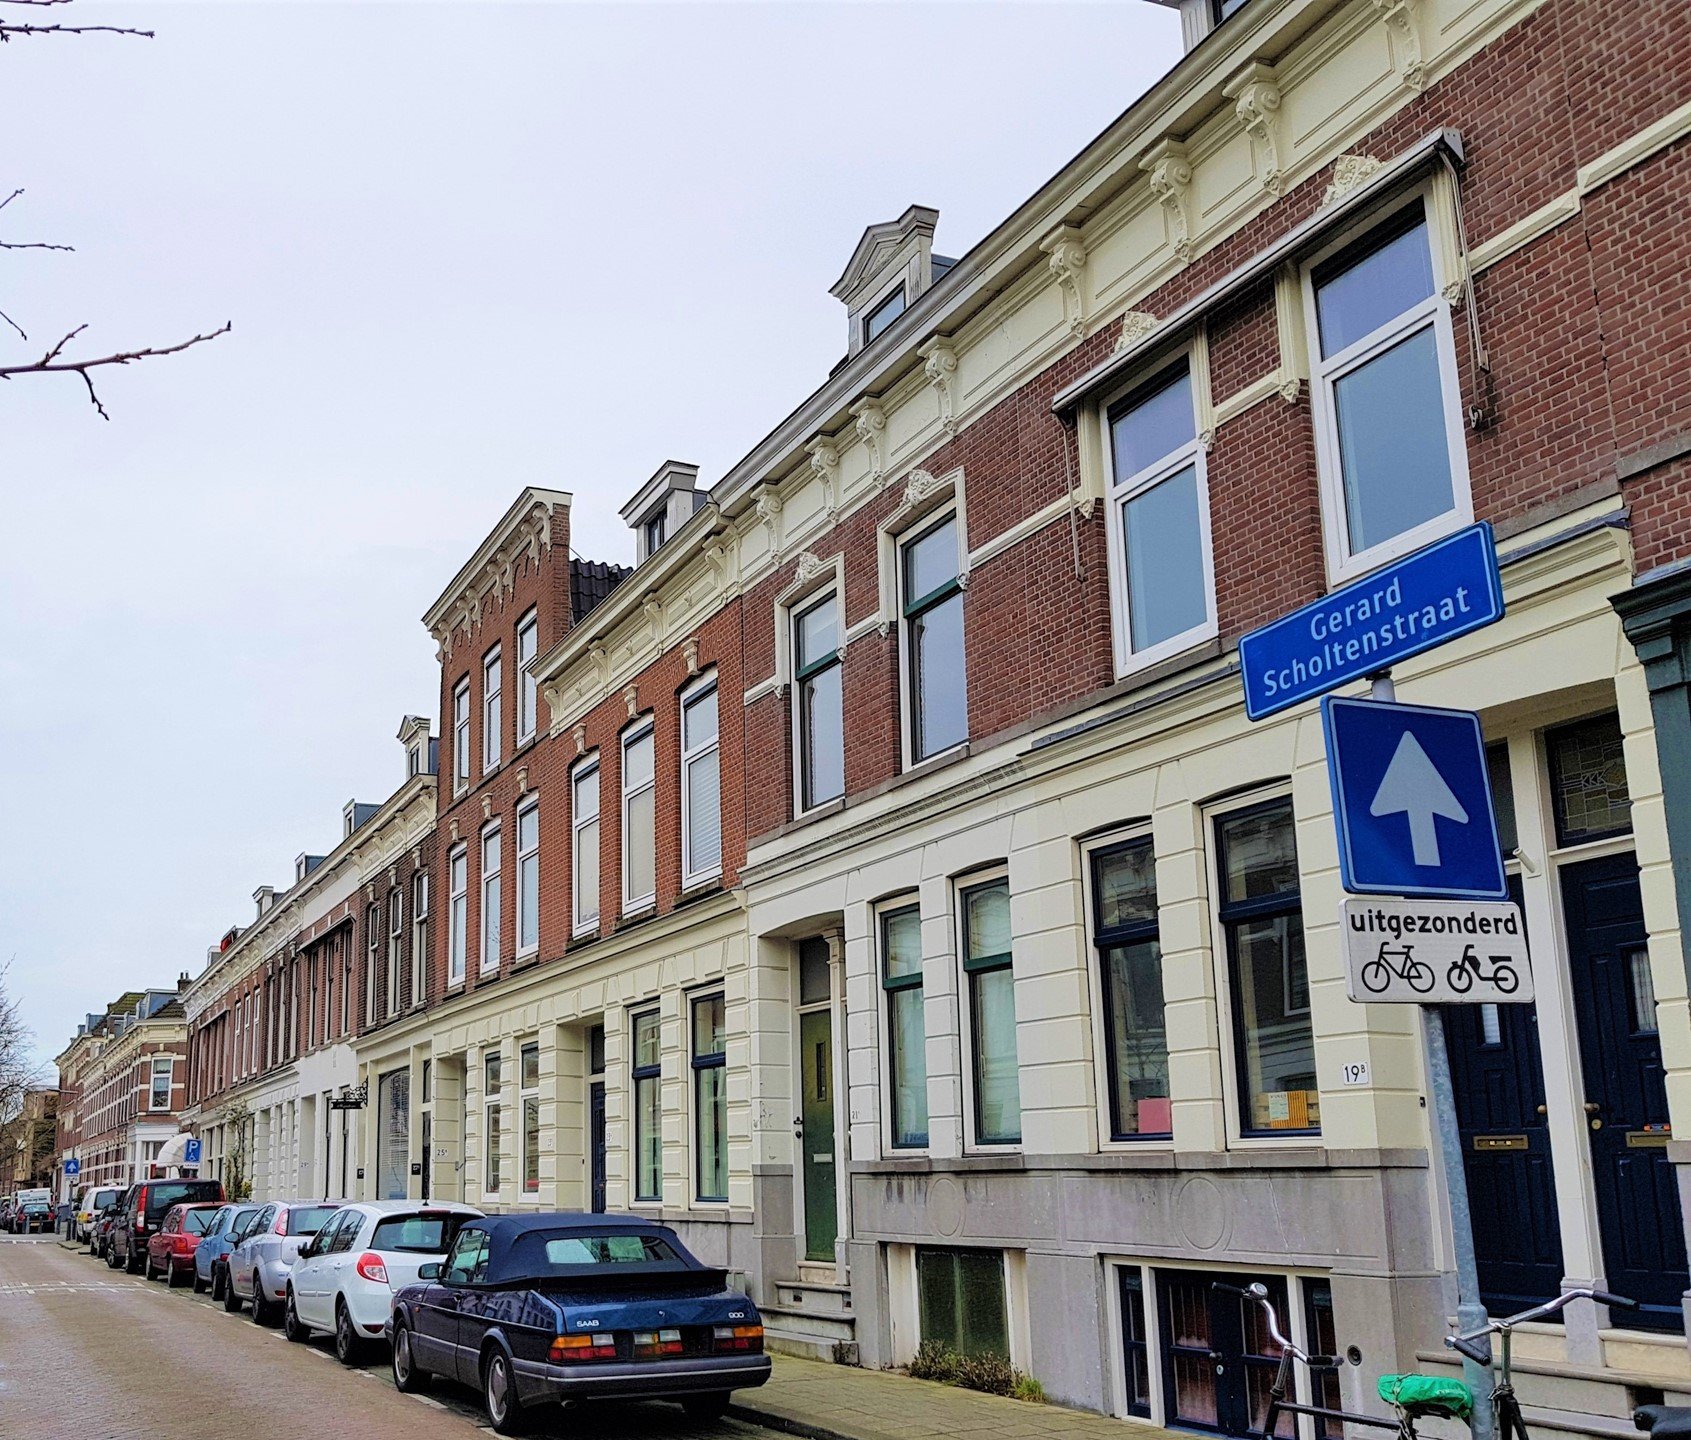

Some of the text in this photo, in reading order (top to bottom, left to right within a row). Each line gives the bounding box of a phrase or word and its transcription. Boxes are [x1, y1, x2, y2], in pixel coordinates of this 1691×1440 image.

[1310, 576, 1402, 641] Gerard
[1263, 586, 1471, 697] Scholtenstraat
[1350, 909, 1518, 940] uitgezonderd
[189, 1140, 199, 1152] P
[576, 1319, 600, 1328] SAAB
[728, 1311, 745, 1319] 900
